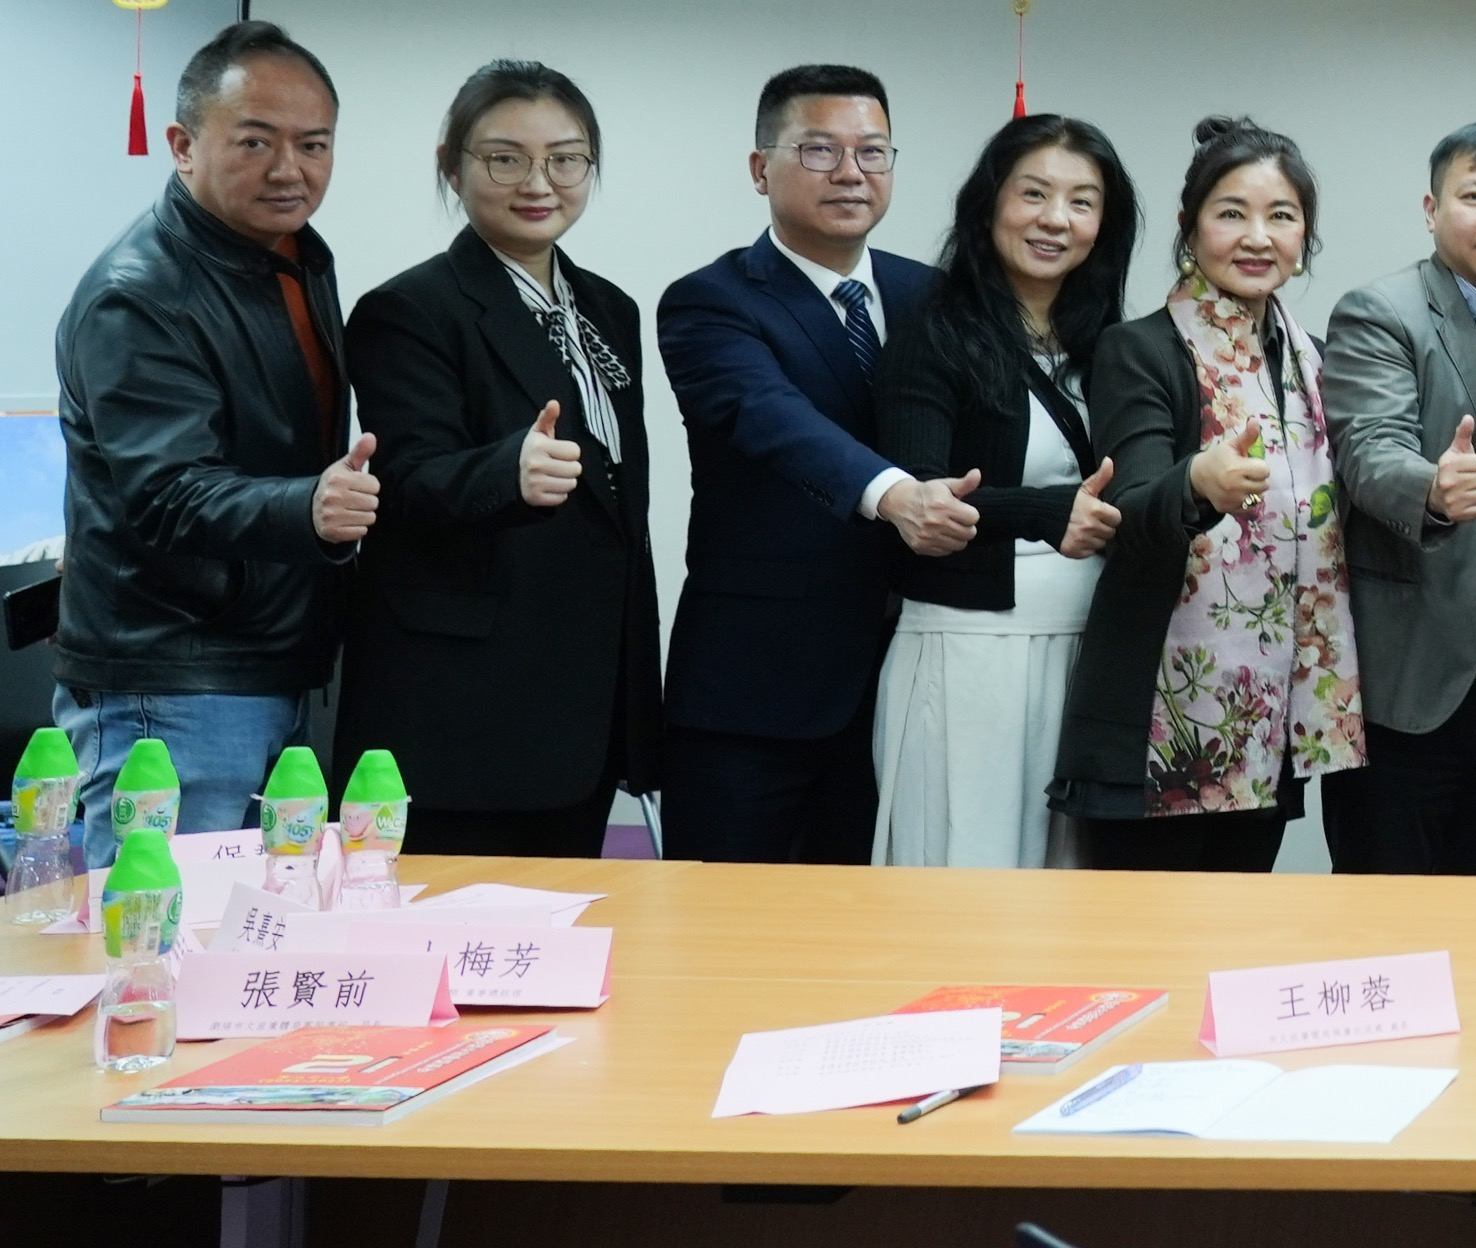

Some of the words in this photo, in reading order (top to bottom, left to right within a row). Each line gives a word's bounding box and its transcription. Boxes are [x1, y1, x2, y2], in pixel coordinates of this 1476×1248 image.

[426, 939, 541, 979] 梅芳
[241, 968, 375, 1010] 張賢前
[1277, 974, 1396, 1021] 王柳蓉
